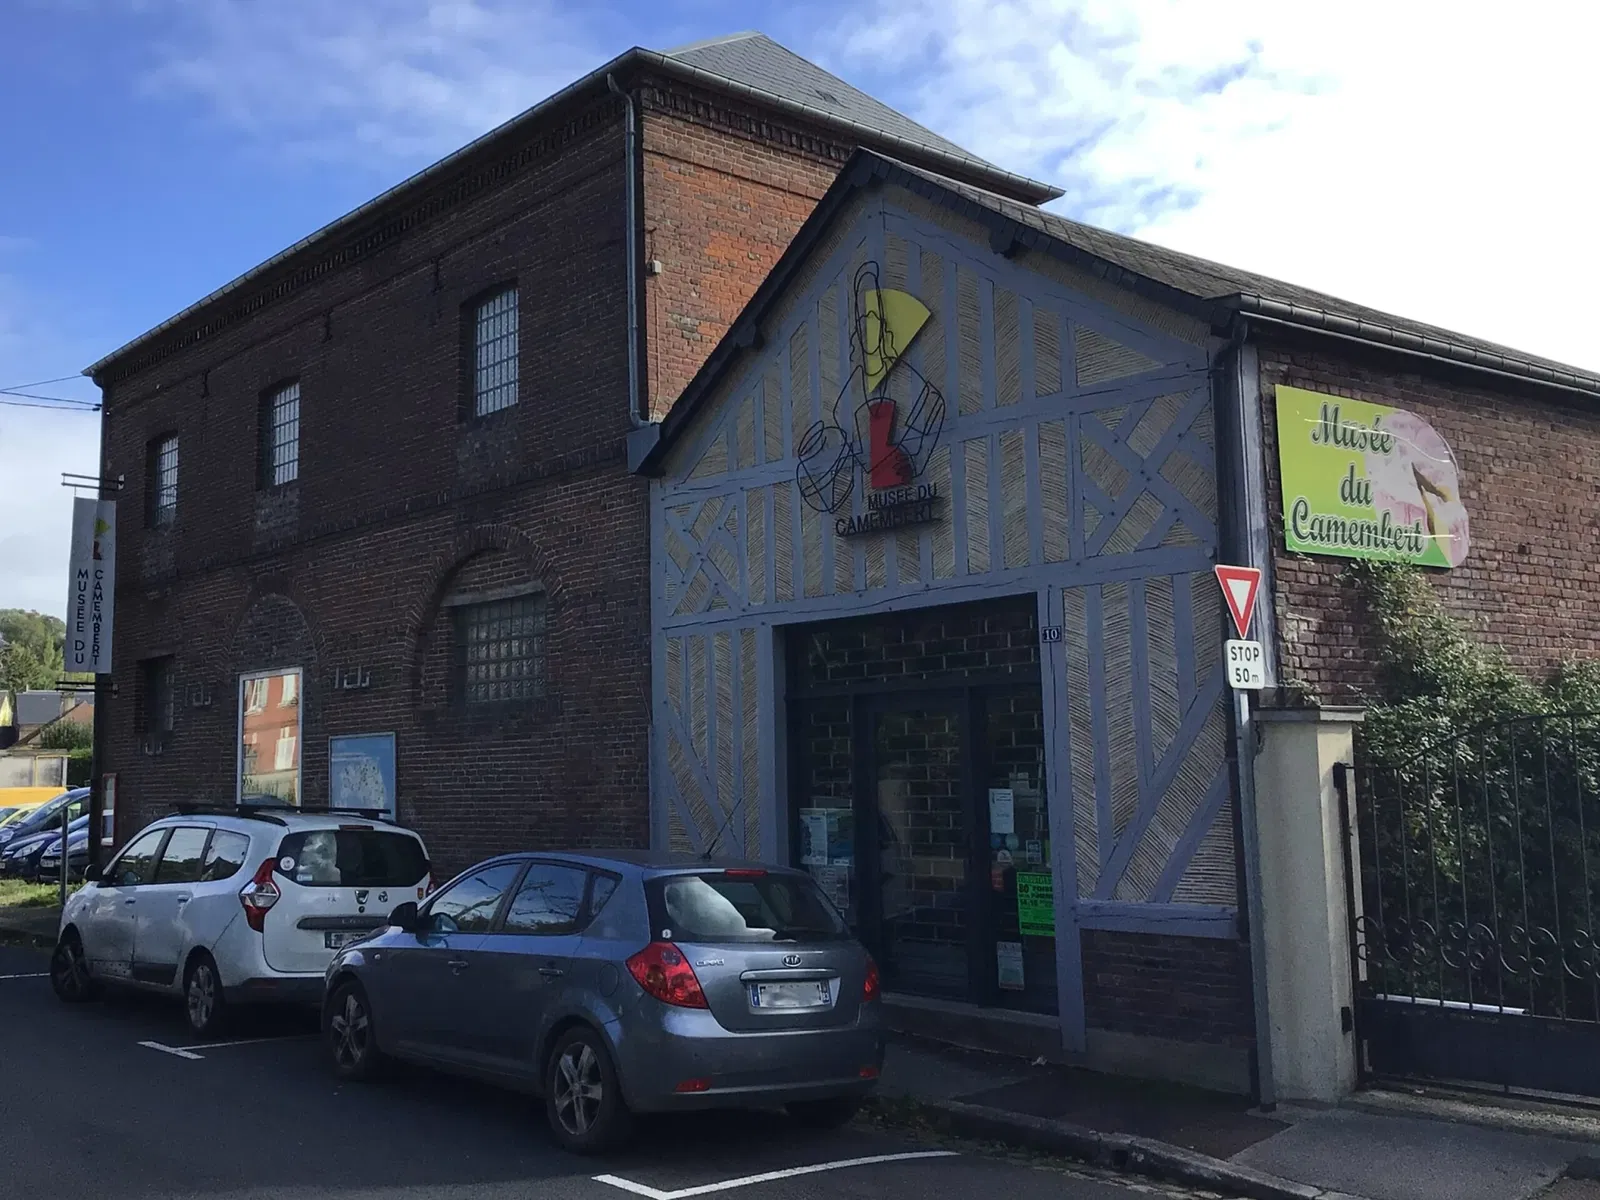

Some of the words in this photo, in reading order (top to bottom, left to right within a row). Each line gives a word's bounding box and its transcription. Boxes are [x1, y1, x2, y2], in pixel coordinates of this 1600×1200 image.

[1312, 404, 1393, 453] Musée
[918, 482, 938, 500] DU
[1341, 464, 1371, 505] du
[1292, 499, 1423, 553] Camembert
[92, 569, 104, 665] CAMEMBERT
[1045, 629, 1058, 640] 10
[75, 640, 85, 664] DU
[1231, 646, 1260, 662] STOP
